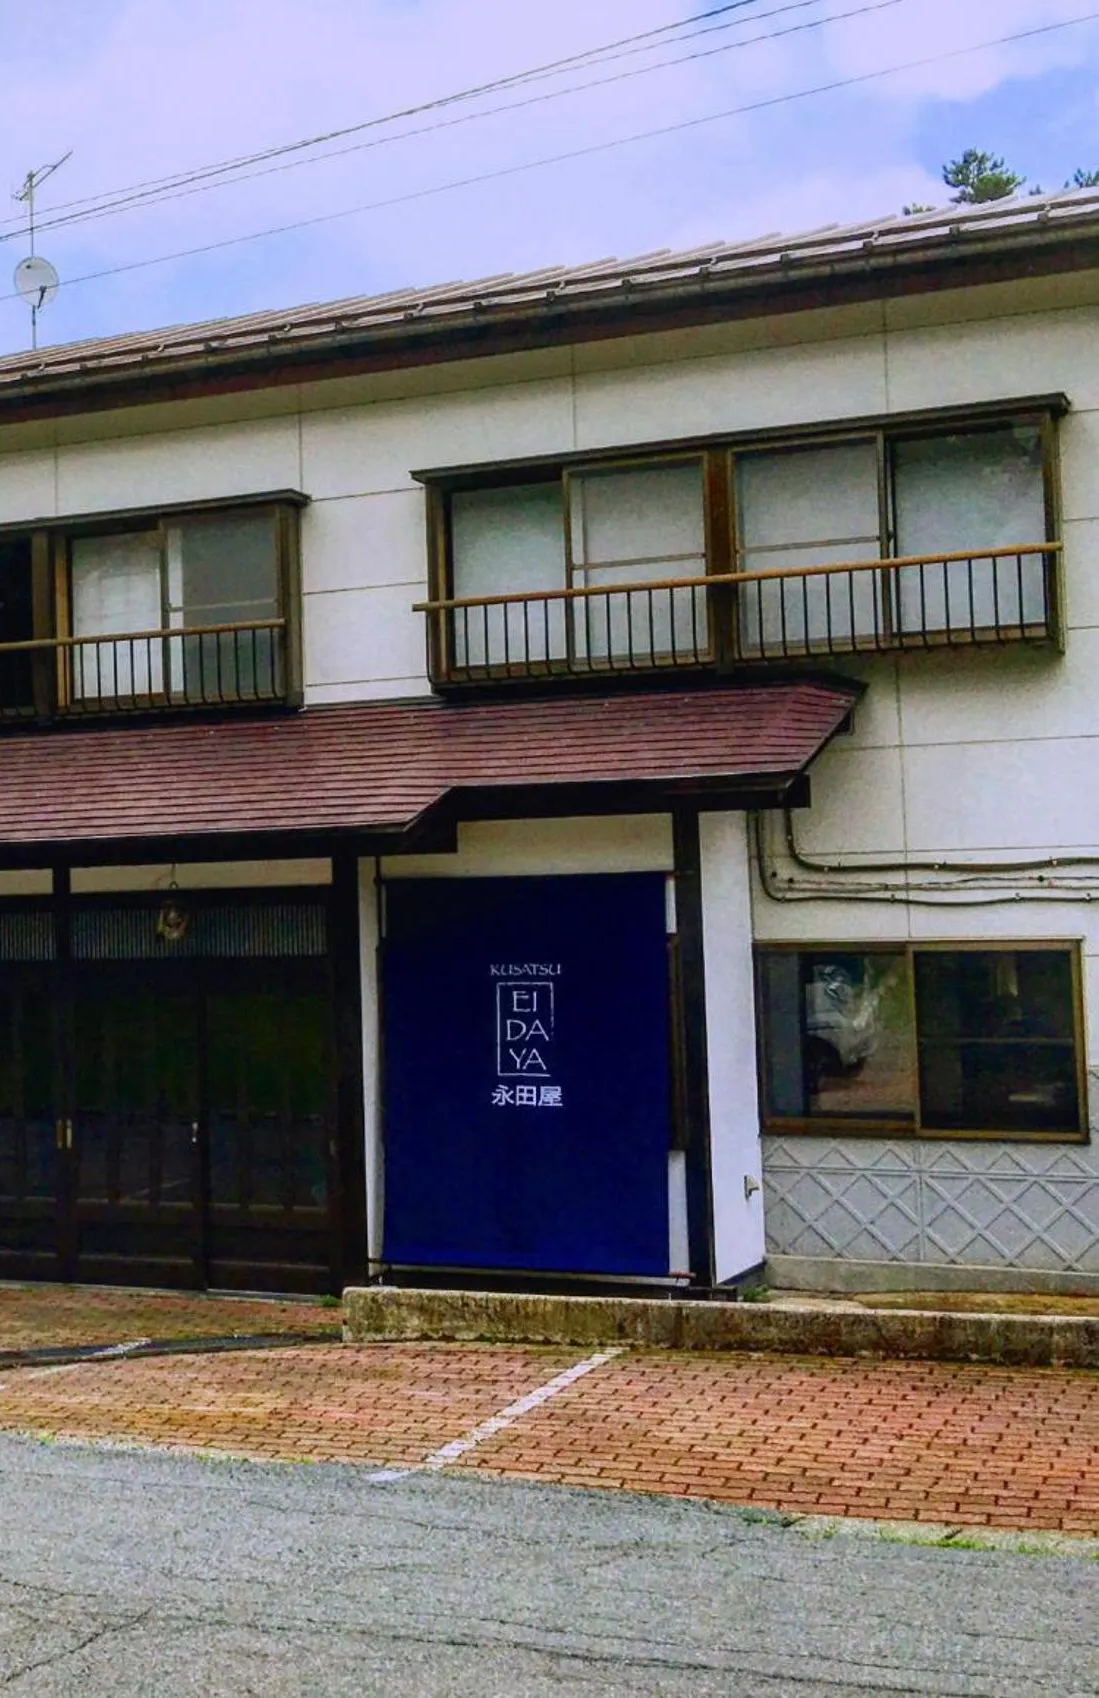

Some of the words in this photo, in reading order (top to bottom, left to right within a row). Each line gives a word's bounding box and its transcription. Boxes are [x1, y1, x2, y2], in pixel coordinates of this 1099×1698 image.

[490, 963, 561, 976] KUSATSU
[513, 990, 537, 1012] EI
[506, 1019, 549, 1041] DA
[509, 1048, 547, 1070] YA
[491, 1084, 563, 1106] 永田屋
